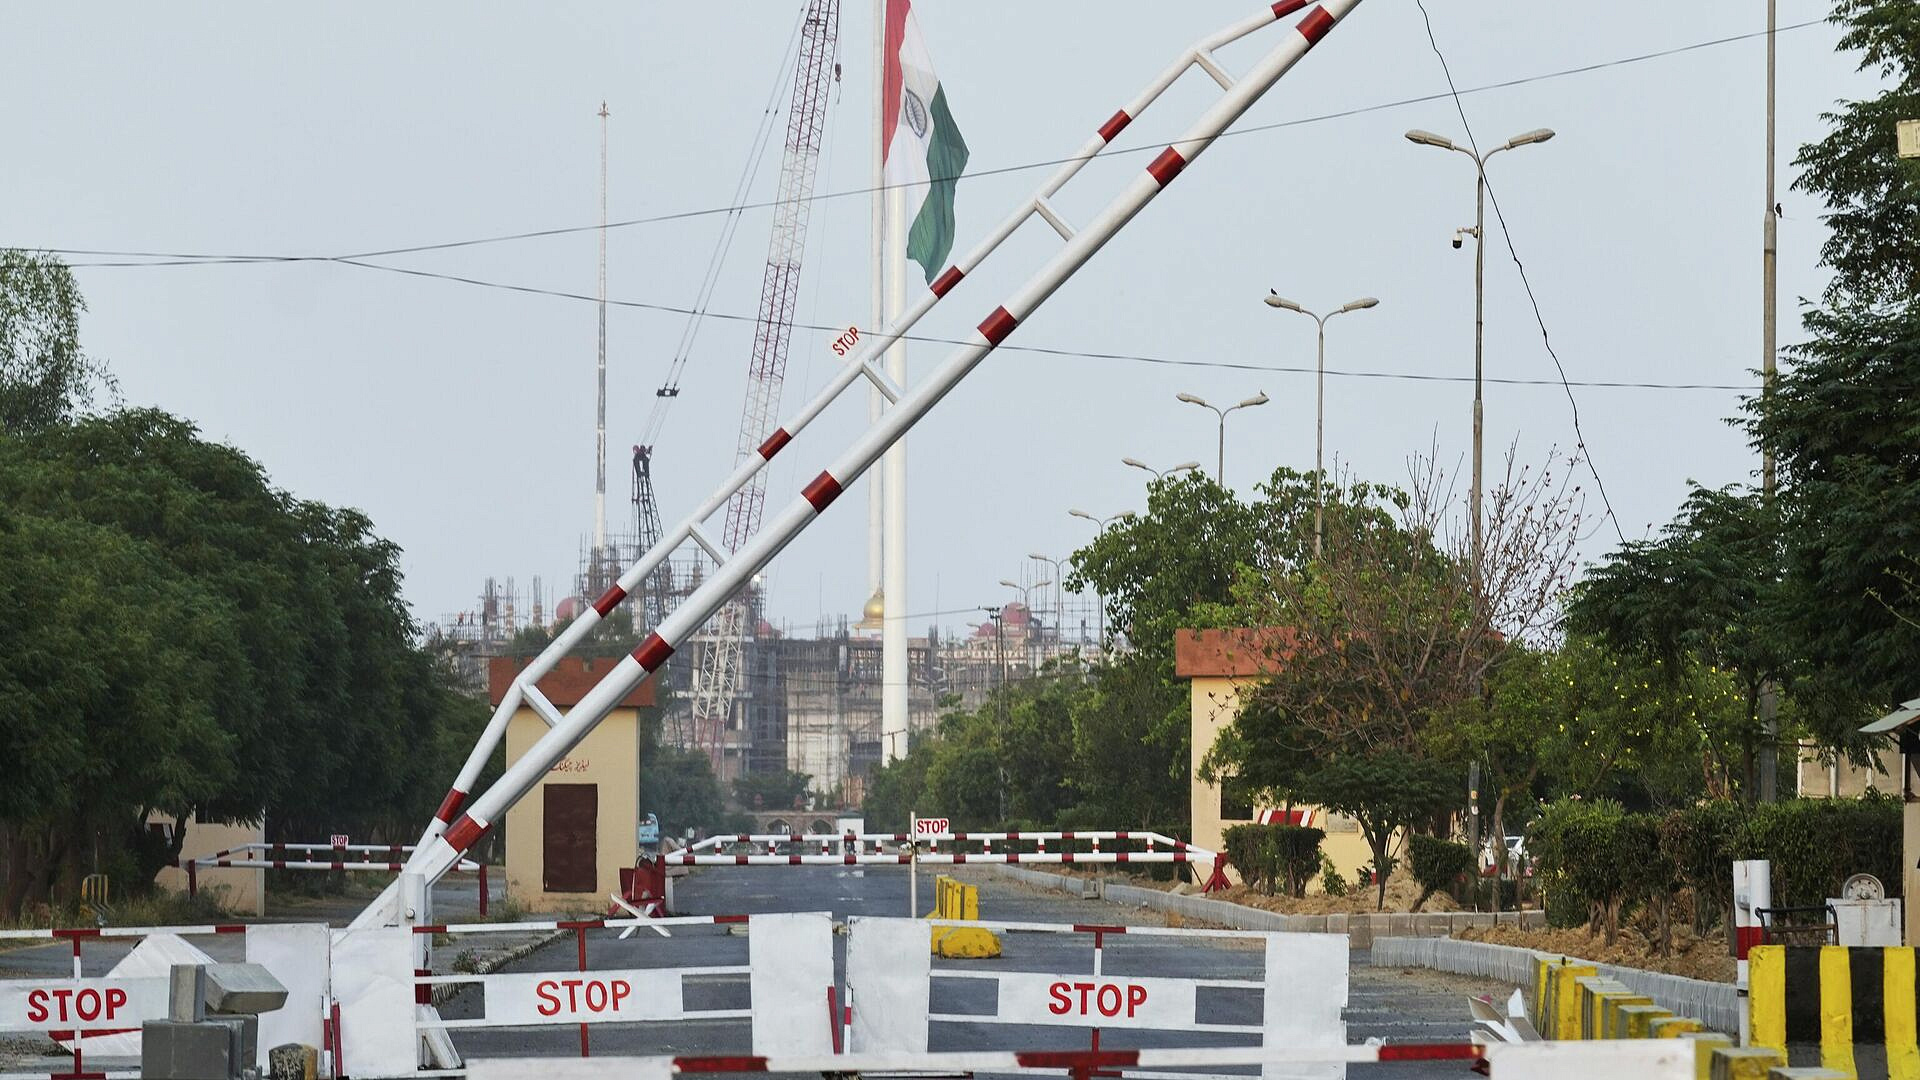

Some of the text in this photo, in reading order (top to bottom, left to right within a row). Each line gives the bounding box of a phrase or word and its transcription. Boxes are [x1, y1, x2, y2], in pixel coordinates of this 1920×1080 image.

[832, 326, 859, 356] STOP
[331, 834, 348, 846] STOP
[917, 819, 948, 833] STOP
[27, 988, 127, 1022] STOP
[536, 979, 631, 1016] STOP
[1048, 982, 1148, 1018] STOP
